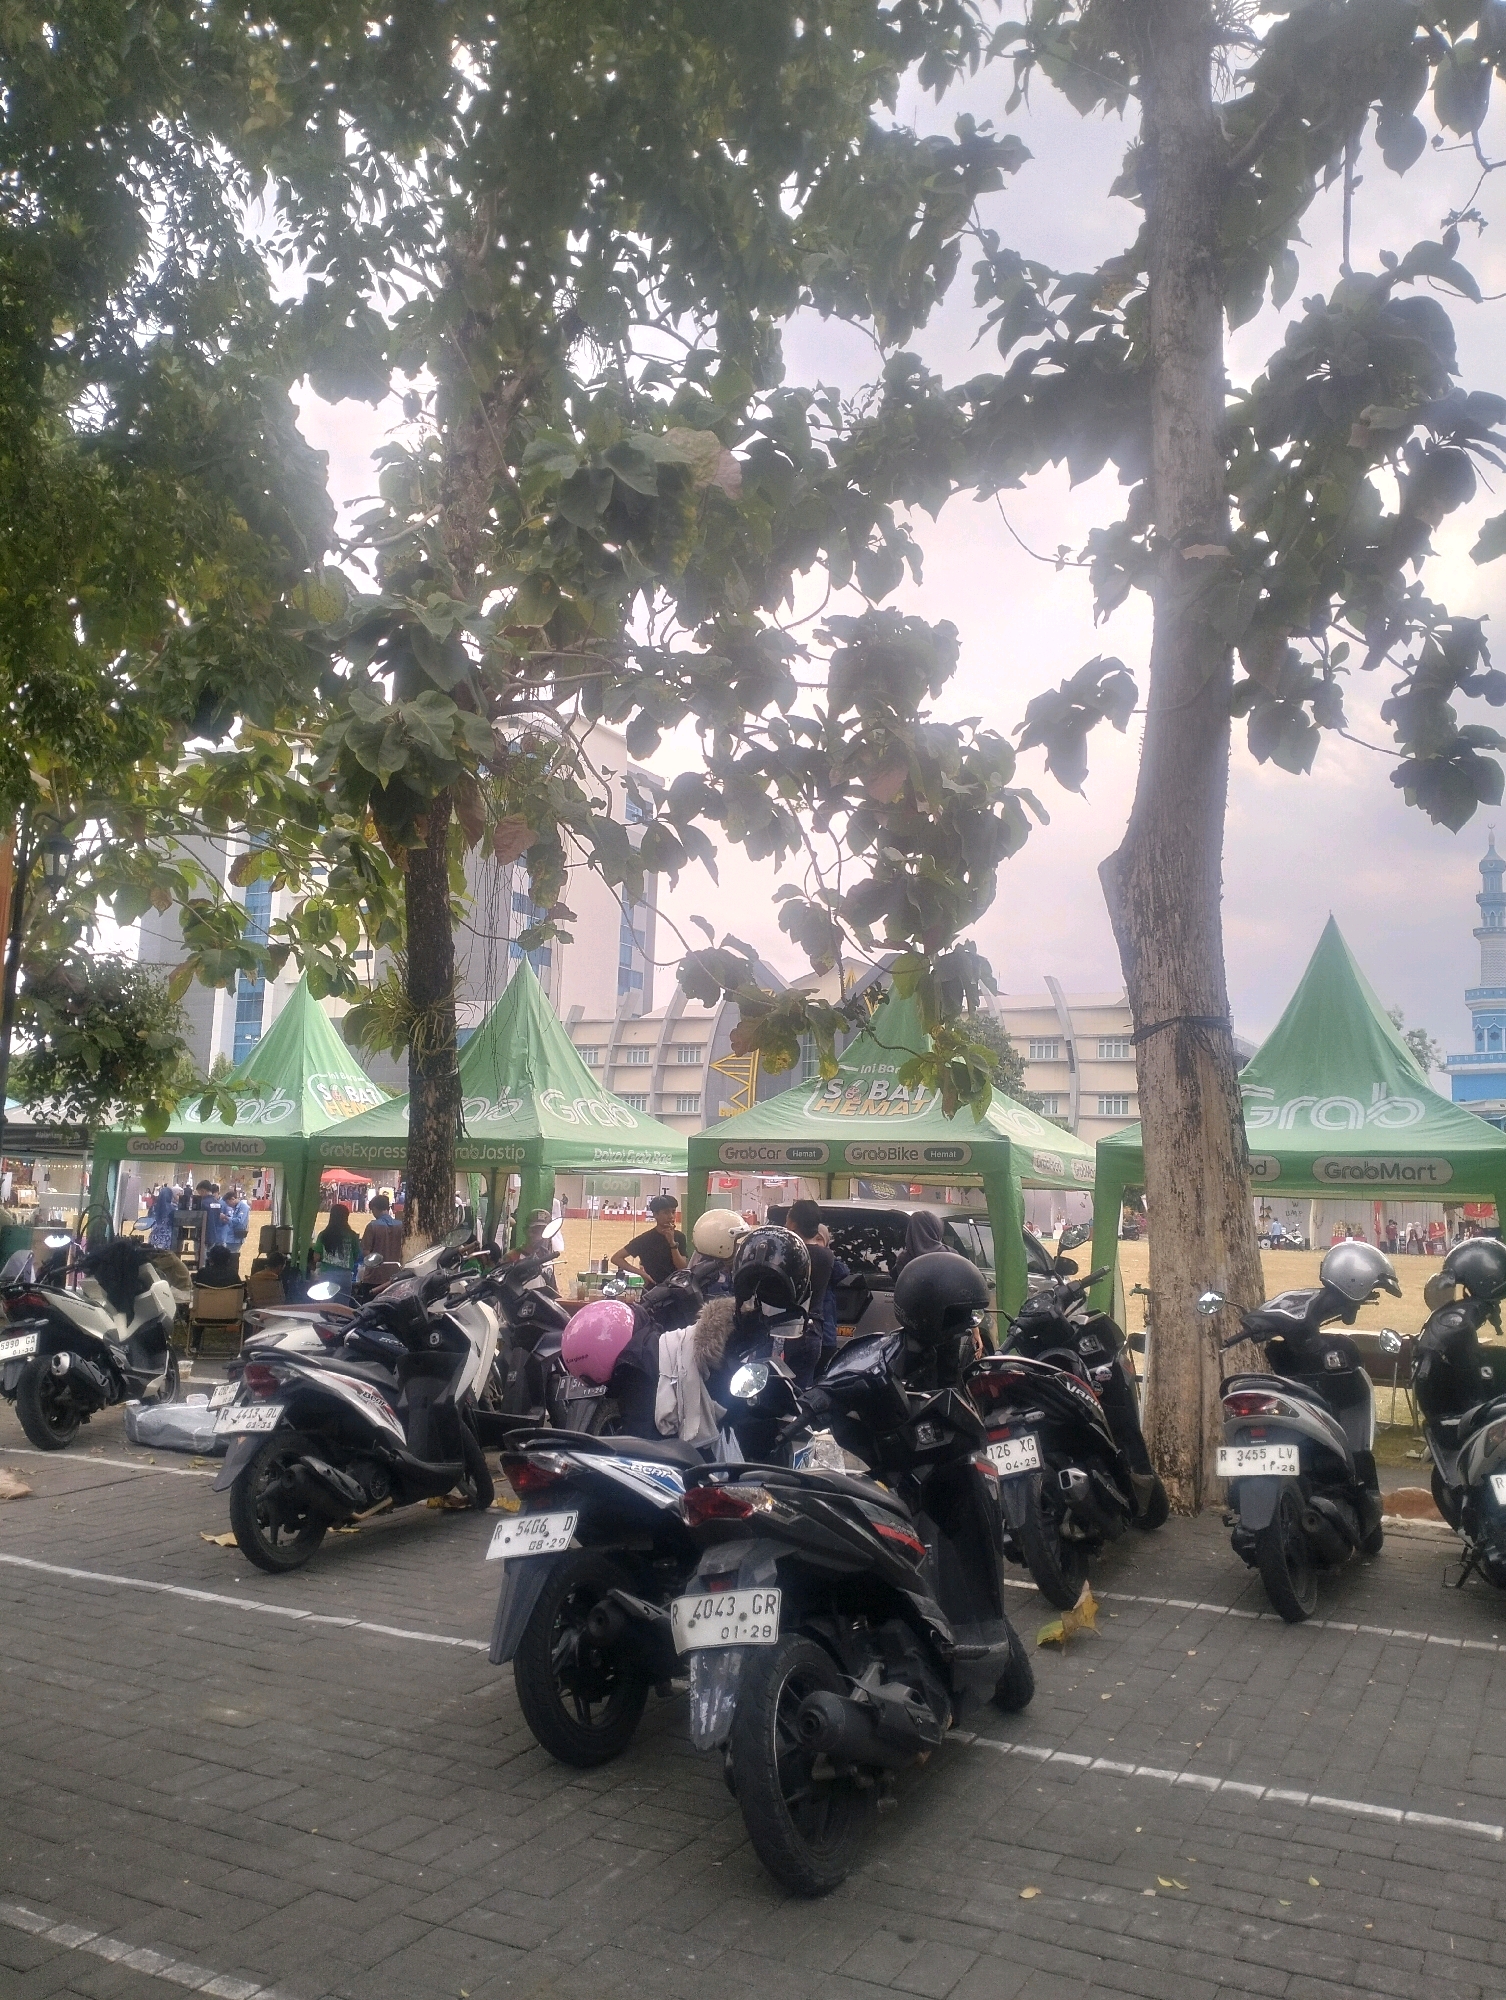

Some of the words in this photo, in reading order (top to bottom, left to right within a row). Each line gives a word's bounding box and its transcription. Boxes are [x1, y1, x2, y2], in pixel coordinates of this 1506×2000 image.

[860, 1064, 876, 1074] Ini
[540, 1088, 638, 1128] Grab
[813, 1098, 931, 1116] HEMAT
[1241, 1082, 1426, 1130] Grab
[132, 1140, 178, 1151] GrabFood
[205, 1140, 258, 1153] GrabMart
[725, 1146, 781, 1160] GrabCar
[793, 1149, 816, 1158] Hemat
[455, 1144, 526, 1163] rabJastip
[851, 1147, 919, 1161] GrabBike
[930, 1150, 956, 1158] Hemat
[1325, 1161, 1437, 1181] GrabMart
[221, 1408, 230, 1421] R
[1019, 1438, 1035, 1453] XG
[1220, 1450, 1227, 1461] R
[1237, 1449, 1267, 1462] 3455
[1278, 1447, 1293, 1459] LV
[494, 1524, 503, 1541] R
[515, 1517, 549, 1537] 5406
[562, 1515, 574, 1532] D
[672, 1603, 679, 1627] R
[692, 1596, 736, 1620] 4043
[752, 1593, 777, 1615] GR
